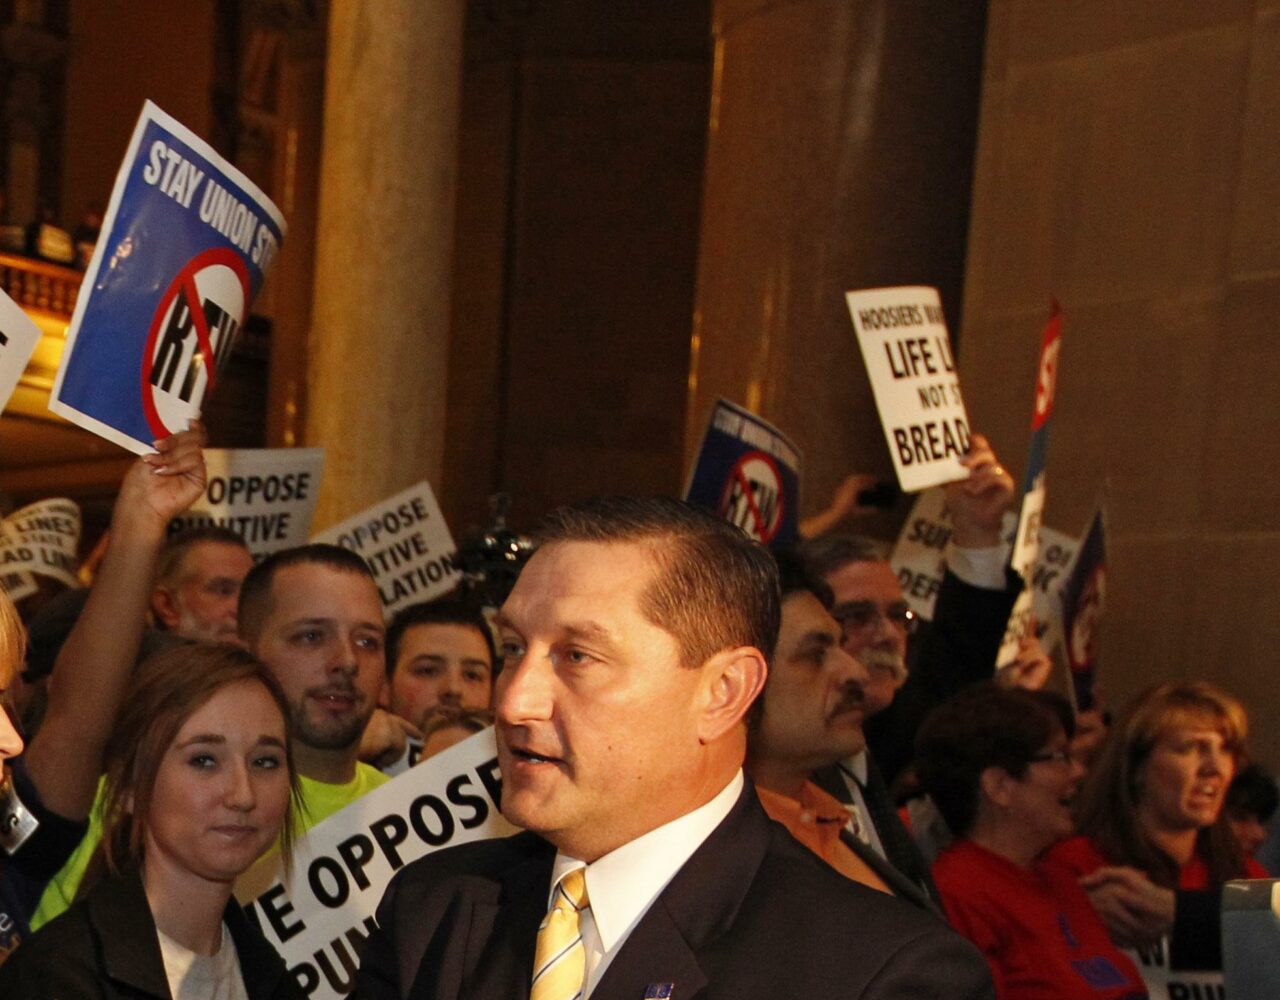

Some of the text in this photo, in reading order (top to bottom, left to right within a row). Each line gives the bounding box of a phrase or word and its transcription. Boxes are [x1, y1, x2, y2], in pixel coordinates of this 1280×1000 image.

[143, 140, 205, 209] STAY
[199, 179, 259, 254] UNION
[884, 338, 936, 380] LIFE
[918, 385, 948, 410] NOT
[893, 417, 970, 467] BREAD
[207, 473, 311, 506] OPPOSE
[336, 497, 429, 550] OPPOSE
[366, 532, 429, 579] ITIVE
[379, 552, 458, 608] LATION
